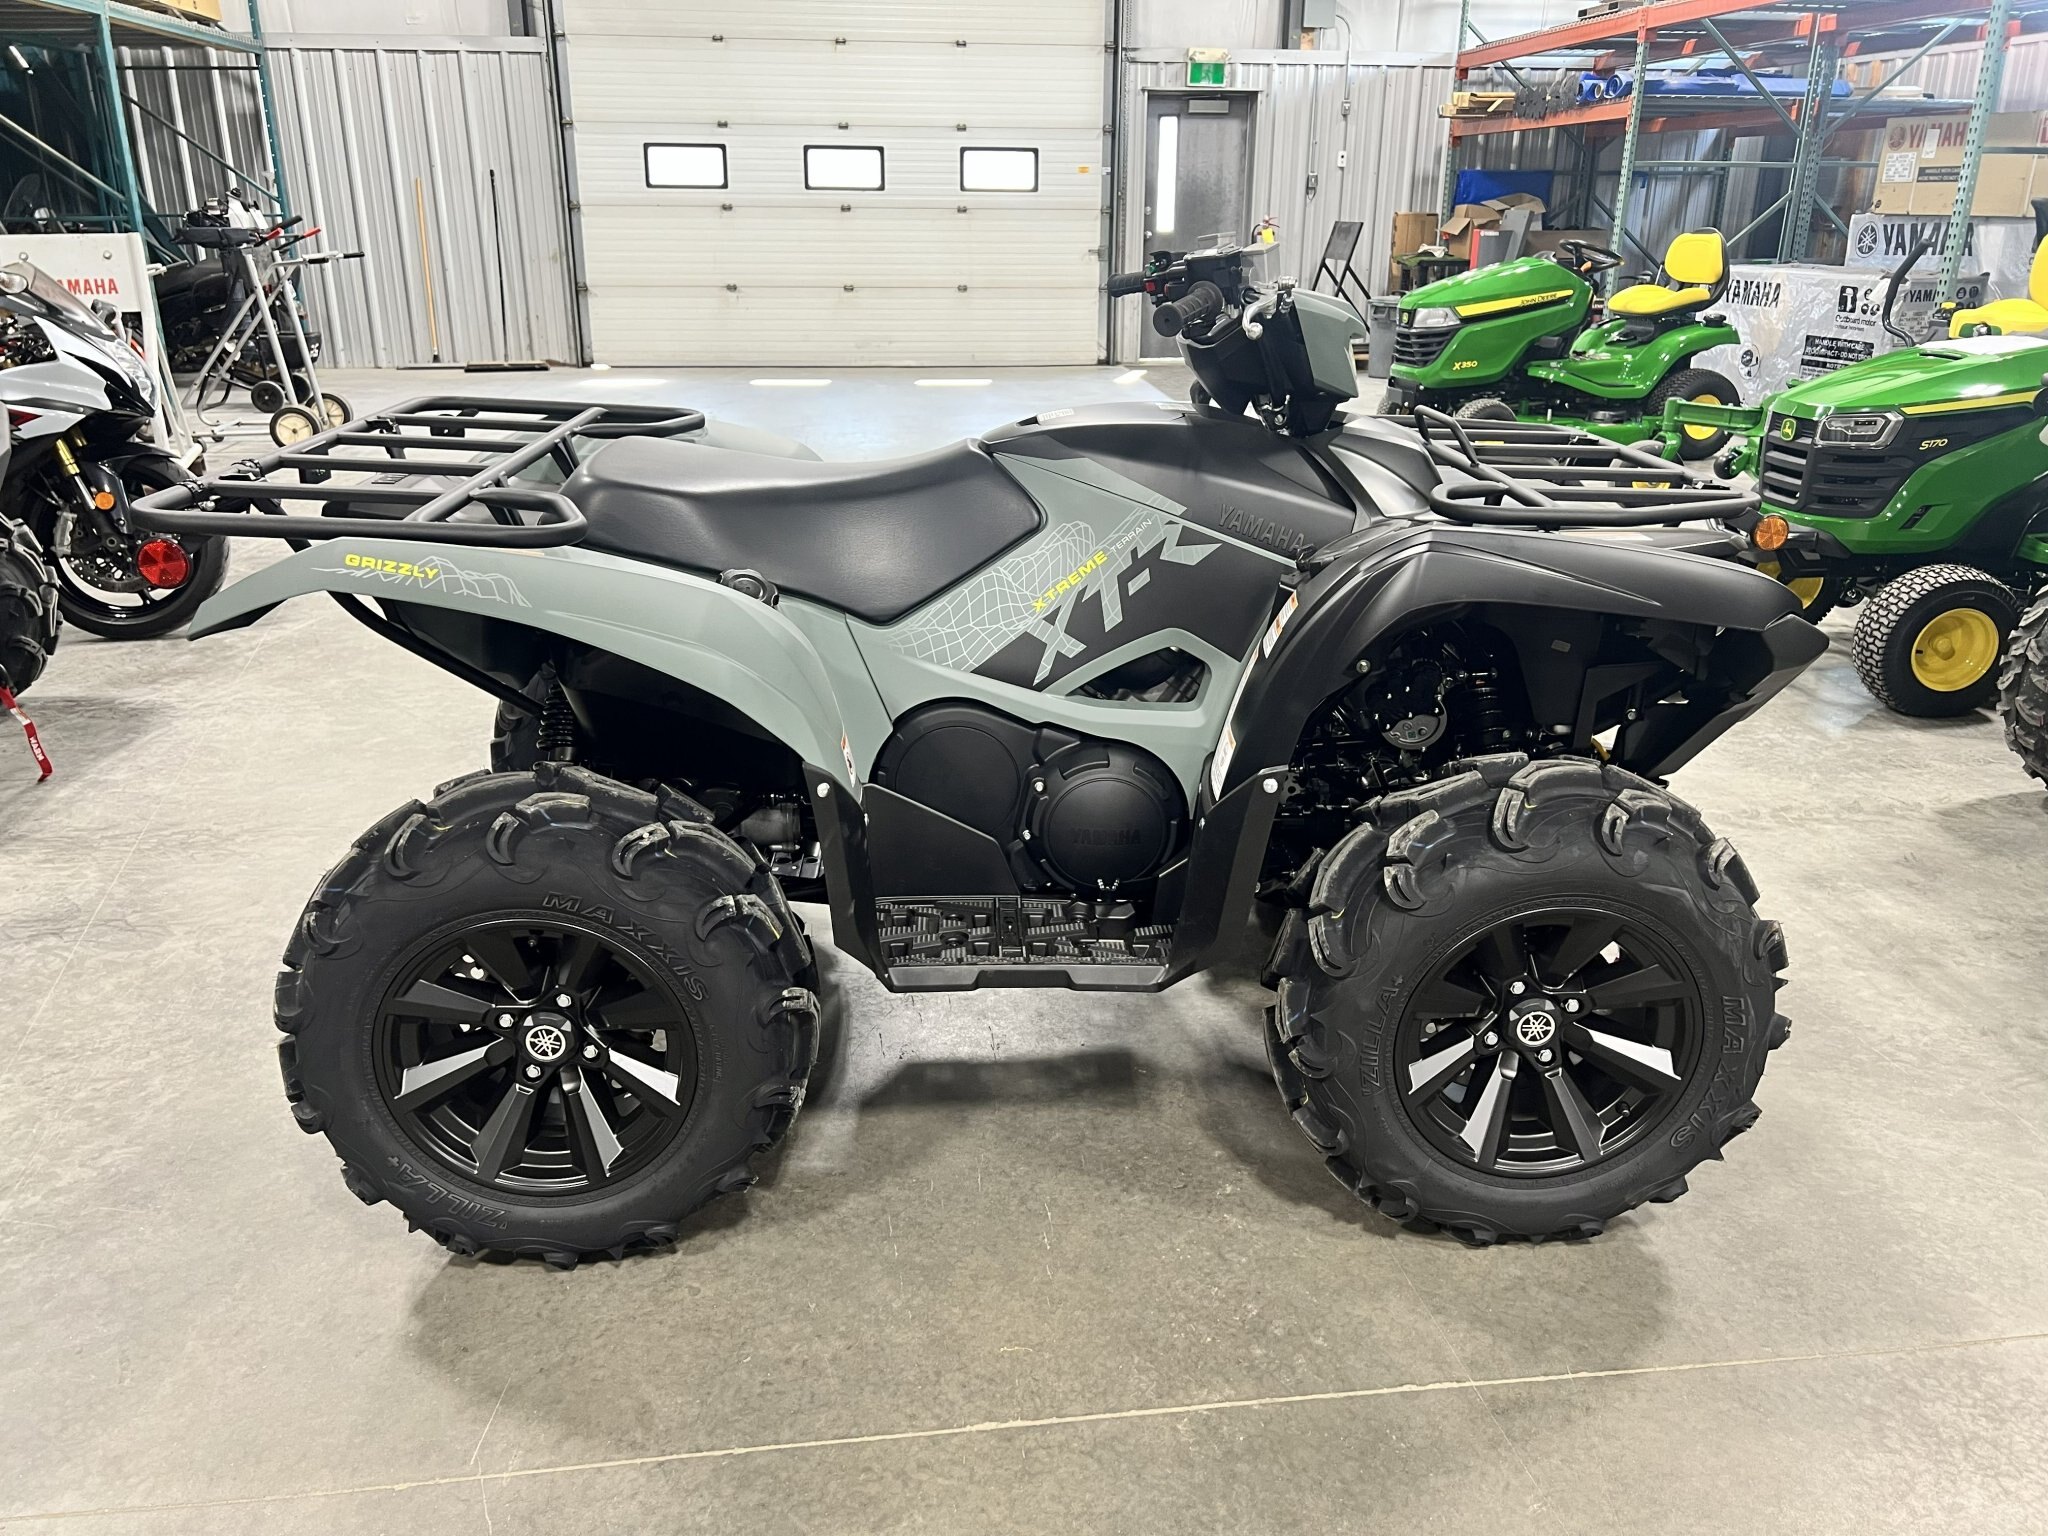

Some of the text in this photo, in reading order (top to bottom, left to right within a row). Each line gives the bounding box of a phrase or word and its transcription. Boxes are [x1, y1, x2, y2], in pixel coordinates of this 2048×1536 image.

[1726, 279, 1781, 308] YAMAHA
[1452, 360, 1478, 371] X350
[1919, 438, 1949, 450] S170
[1218, 503, 1307, 553] YAMAHA
[344, 553, 440, 580] GRIZZLY
[1032, 518, 1153, 613] XTREME TERRAIN
[541, 890, 708, 1002] MAXXIS
[1669, 994, 1748, 1149] MAXXIS
